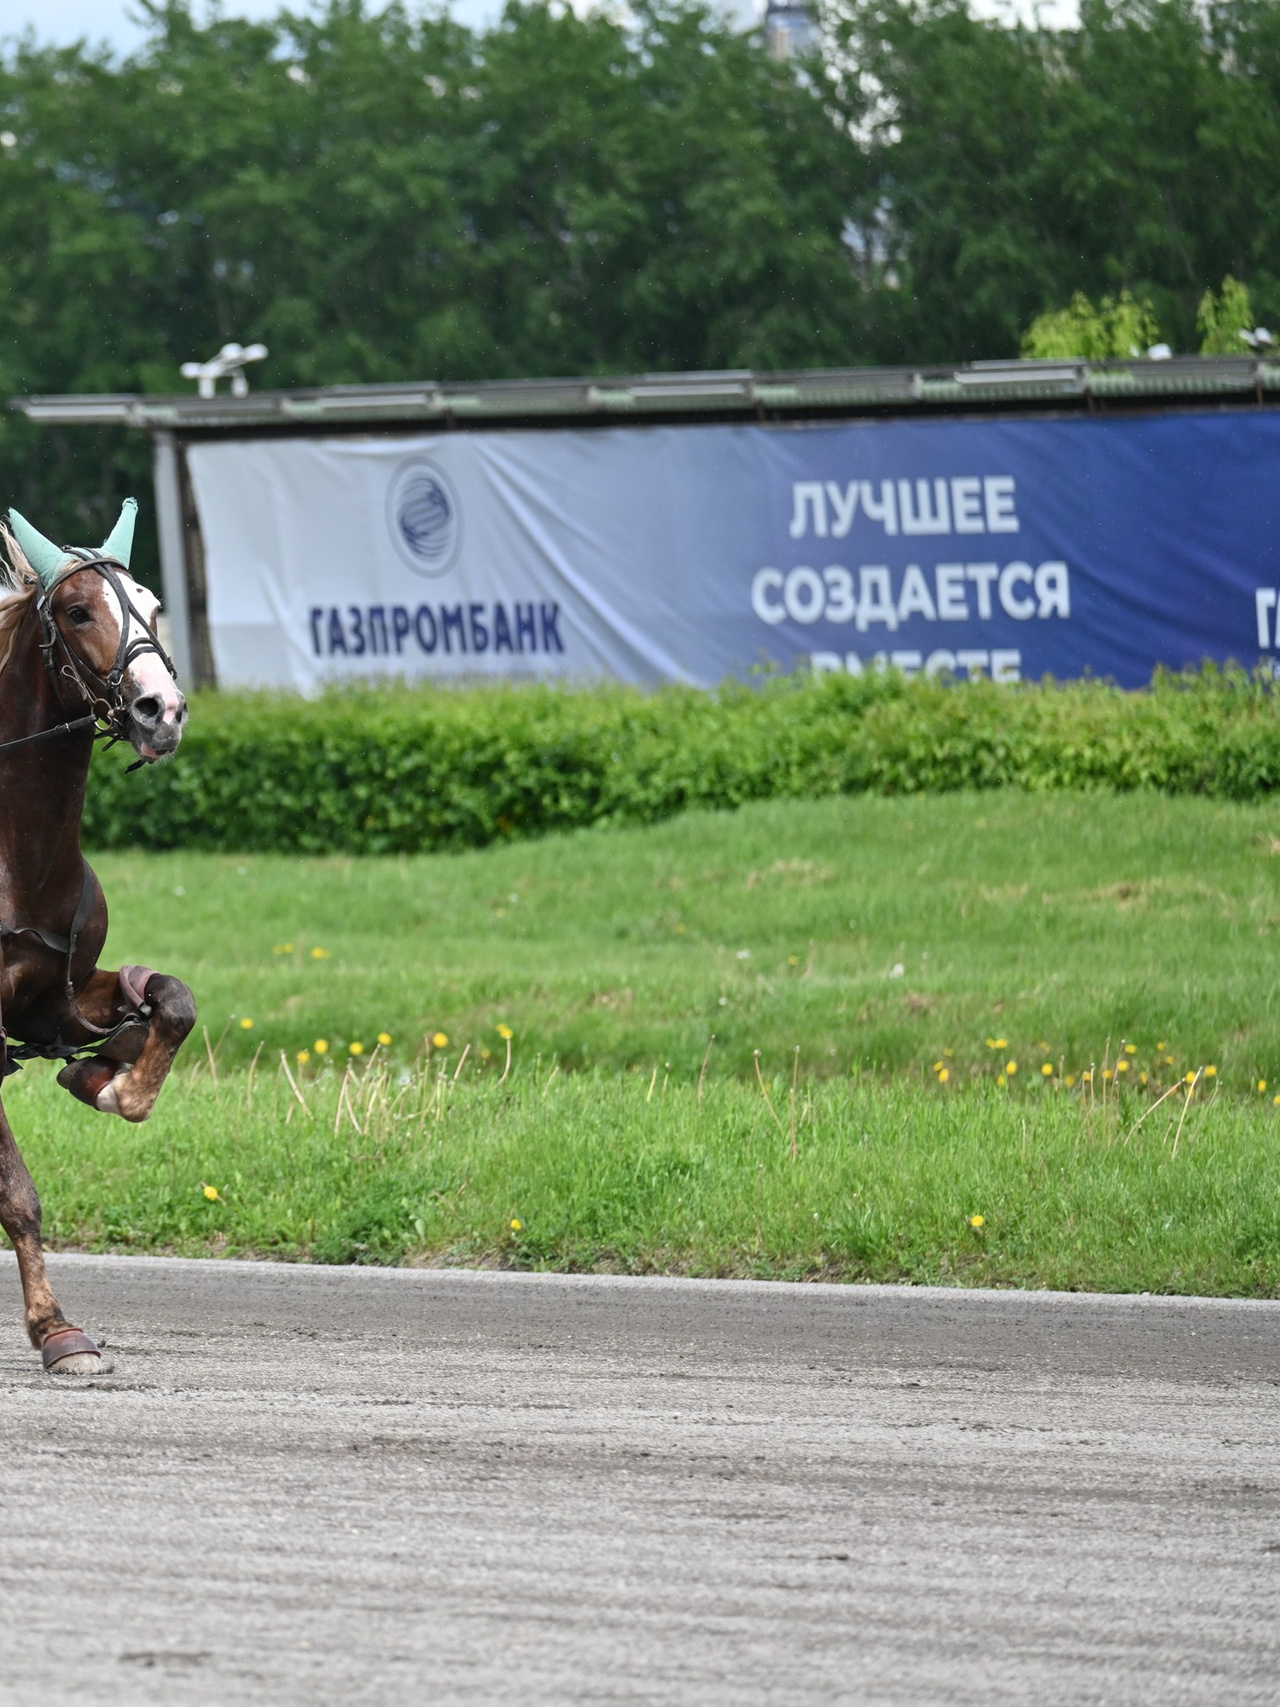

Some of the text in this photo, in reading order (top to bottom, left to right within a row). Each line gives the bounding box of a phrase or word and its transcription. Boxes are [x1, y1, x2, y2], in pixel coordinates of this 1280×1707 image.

[789, 475, 1019, 539] ЛУЧШЕЕ
[751, 560, 1070, 632] СОЗДАЕТСЯ
[1255, 586, 1280, 650] Г
[310, 602, 564, 656] ГАЗПРОМБАНК
